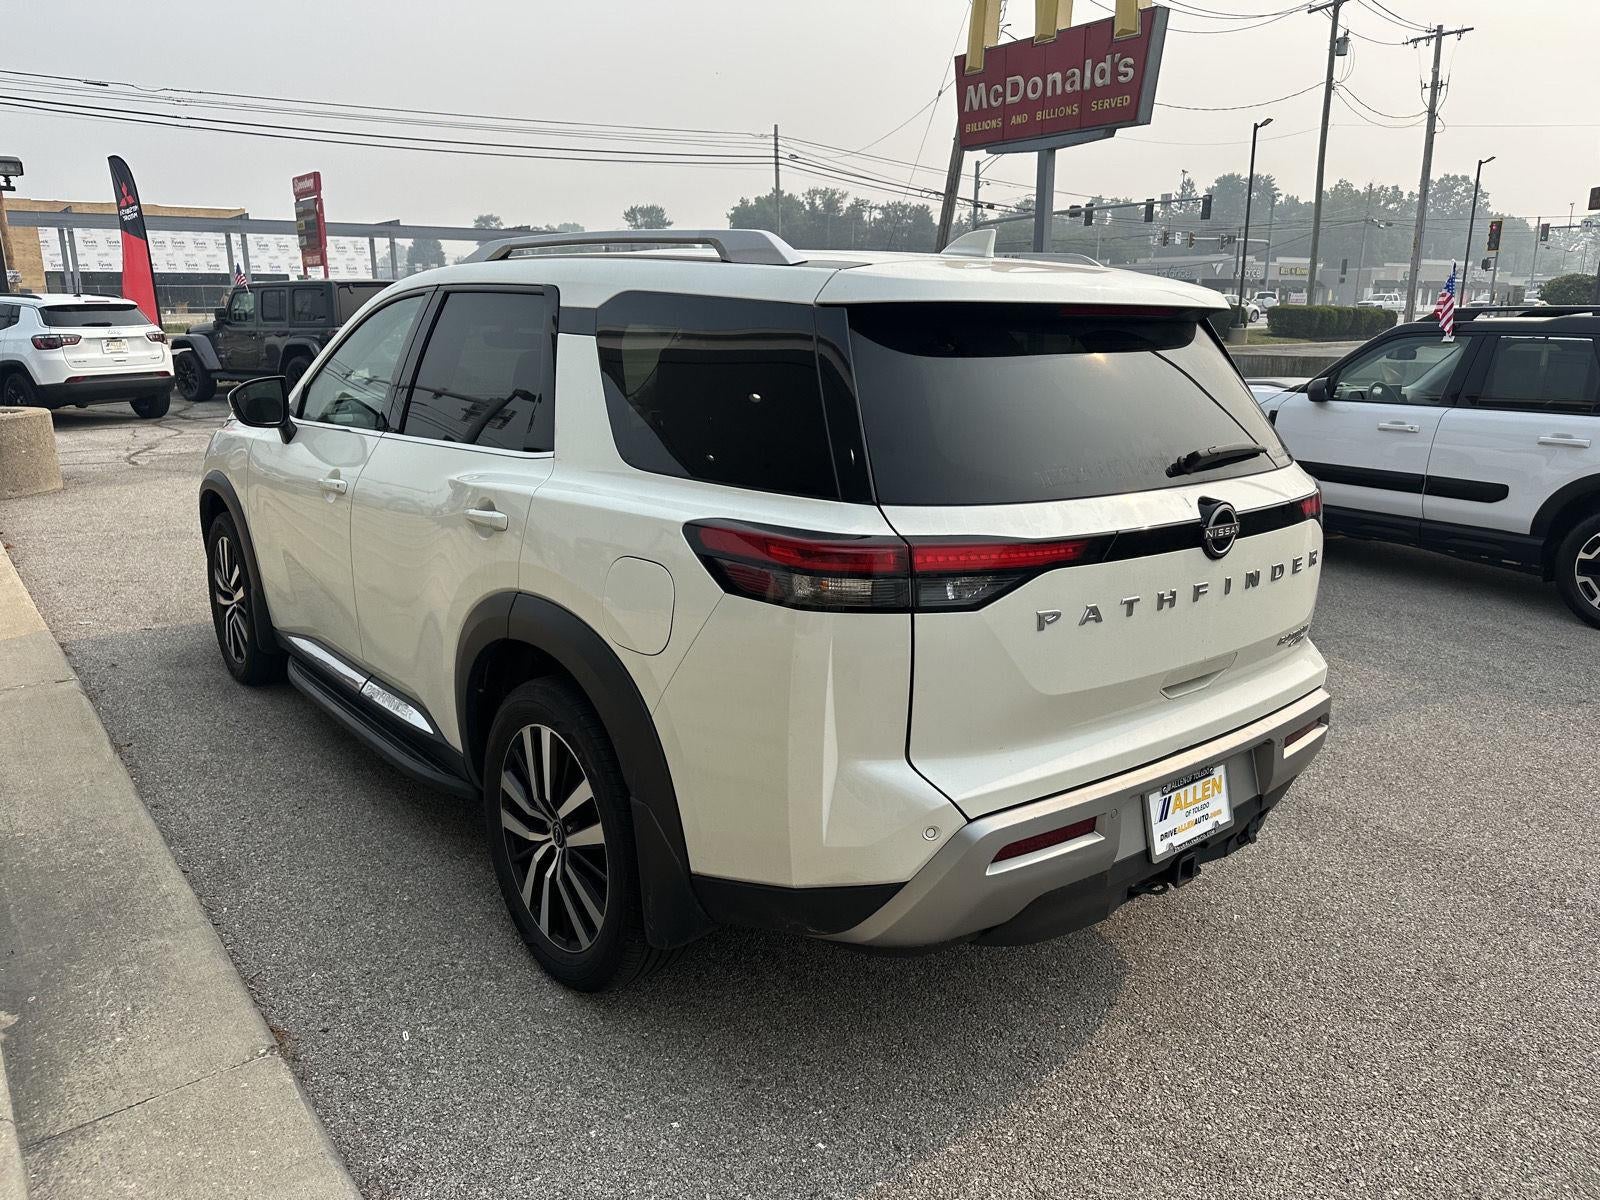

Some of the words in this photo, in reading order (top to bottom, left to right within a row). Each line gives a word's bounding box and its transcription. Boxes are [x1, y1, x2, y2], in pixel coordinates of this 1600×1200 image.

[964, 52, 1135, 112] McDonald's
[965, 117, 1002, 133] BILLIONS
[1010, 112, 1028, 126] AND
[1036, 103, 1080, 121] BILLIONS
[1091, 95, 1131, 112] SERVED
[1205, 524, 1240, 538] NISSAN
[1036, 550, 1318, 631] PATHFINDER
[1171, 777, 1186, 789] ALLEN
[1171, 774, 1223, 815] ALLEN
[1185, 809, 1192, 818] OF
[1192, 801, 1210, 814] TOLEDO
